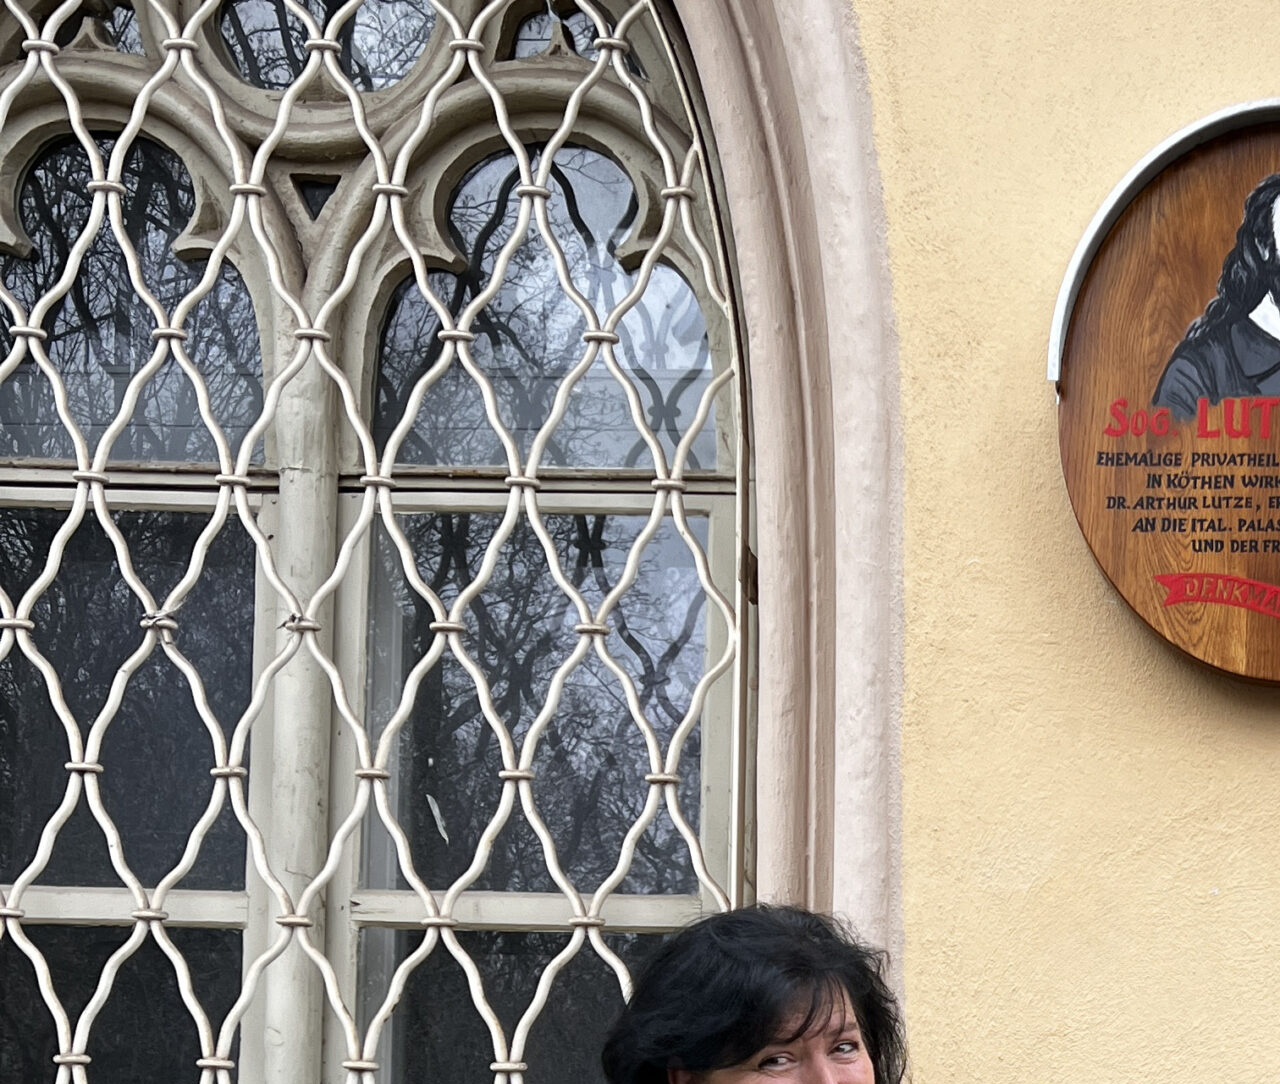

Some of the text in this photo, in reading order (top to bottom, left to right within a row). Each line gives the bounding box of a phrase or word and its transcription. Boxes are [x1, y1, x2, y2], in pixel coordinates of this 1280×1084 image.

[1096, 451, 1182, 467] EHEMALIGE
[1146, 473, 1162, 489] IN
[1166, 471, 1235, 490] KÖTHEN
[1106, 496, 1130, 510] DR.
[1132, 496, 1198, 511] ARTHUR
[1131, 517, 1159, 533] AN
[1161, 517, 1187, 533] DIE
[1191, 518, 1232, 532] ITAL.
[1191, 539, 1224, 553] UND
[1230, 538, 1259, 553] DER
